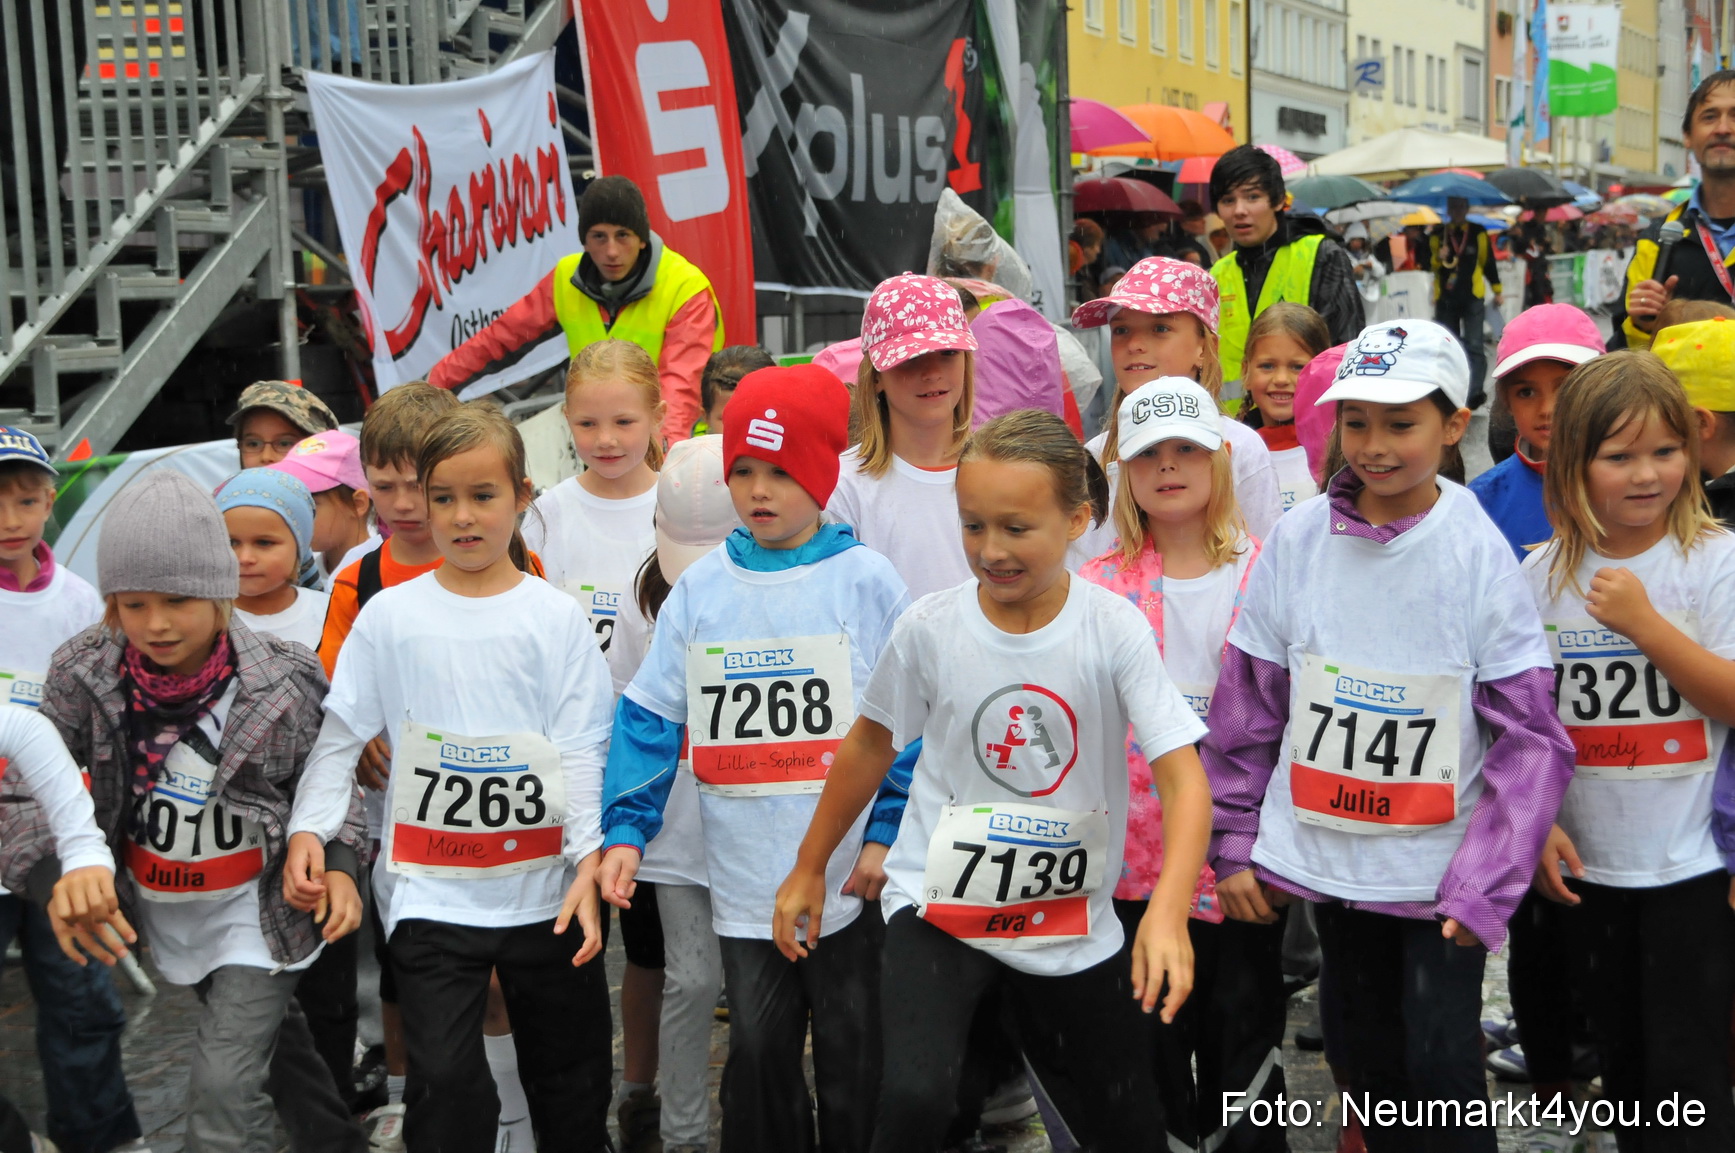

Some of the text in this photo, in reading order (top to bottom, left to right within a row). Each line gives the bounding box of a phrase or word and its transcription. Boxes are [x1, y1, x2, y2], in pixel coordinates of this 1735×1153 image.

[356, 90, 566, 361] Charivari
[1132, 392, 1200, 425] CSB
[592, 591, 621, 607] BO
[724, 648, 794, 669] BOCK
[10, 680, 45, 698] BO
[1335, 675, 1406, 704] BOCK
[701, 678, 833, 740] 7268
[440, 743, 511, 763] BOCK
[1306, 702, 1436, 777] 7147
[414, 767, 546, 828] 7263
[1329, 784, 1391, 817] Julia
[988, 813, 1070, 838] BOCK
[427, 833, 488, 859] Marie
[146, 862, 205, 887] Julia
[951, 841, 1088, 903] 7139
[985, 914, 1027, 932] Eva
